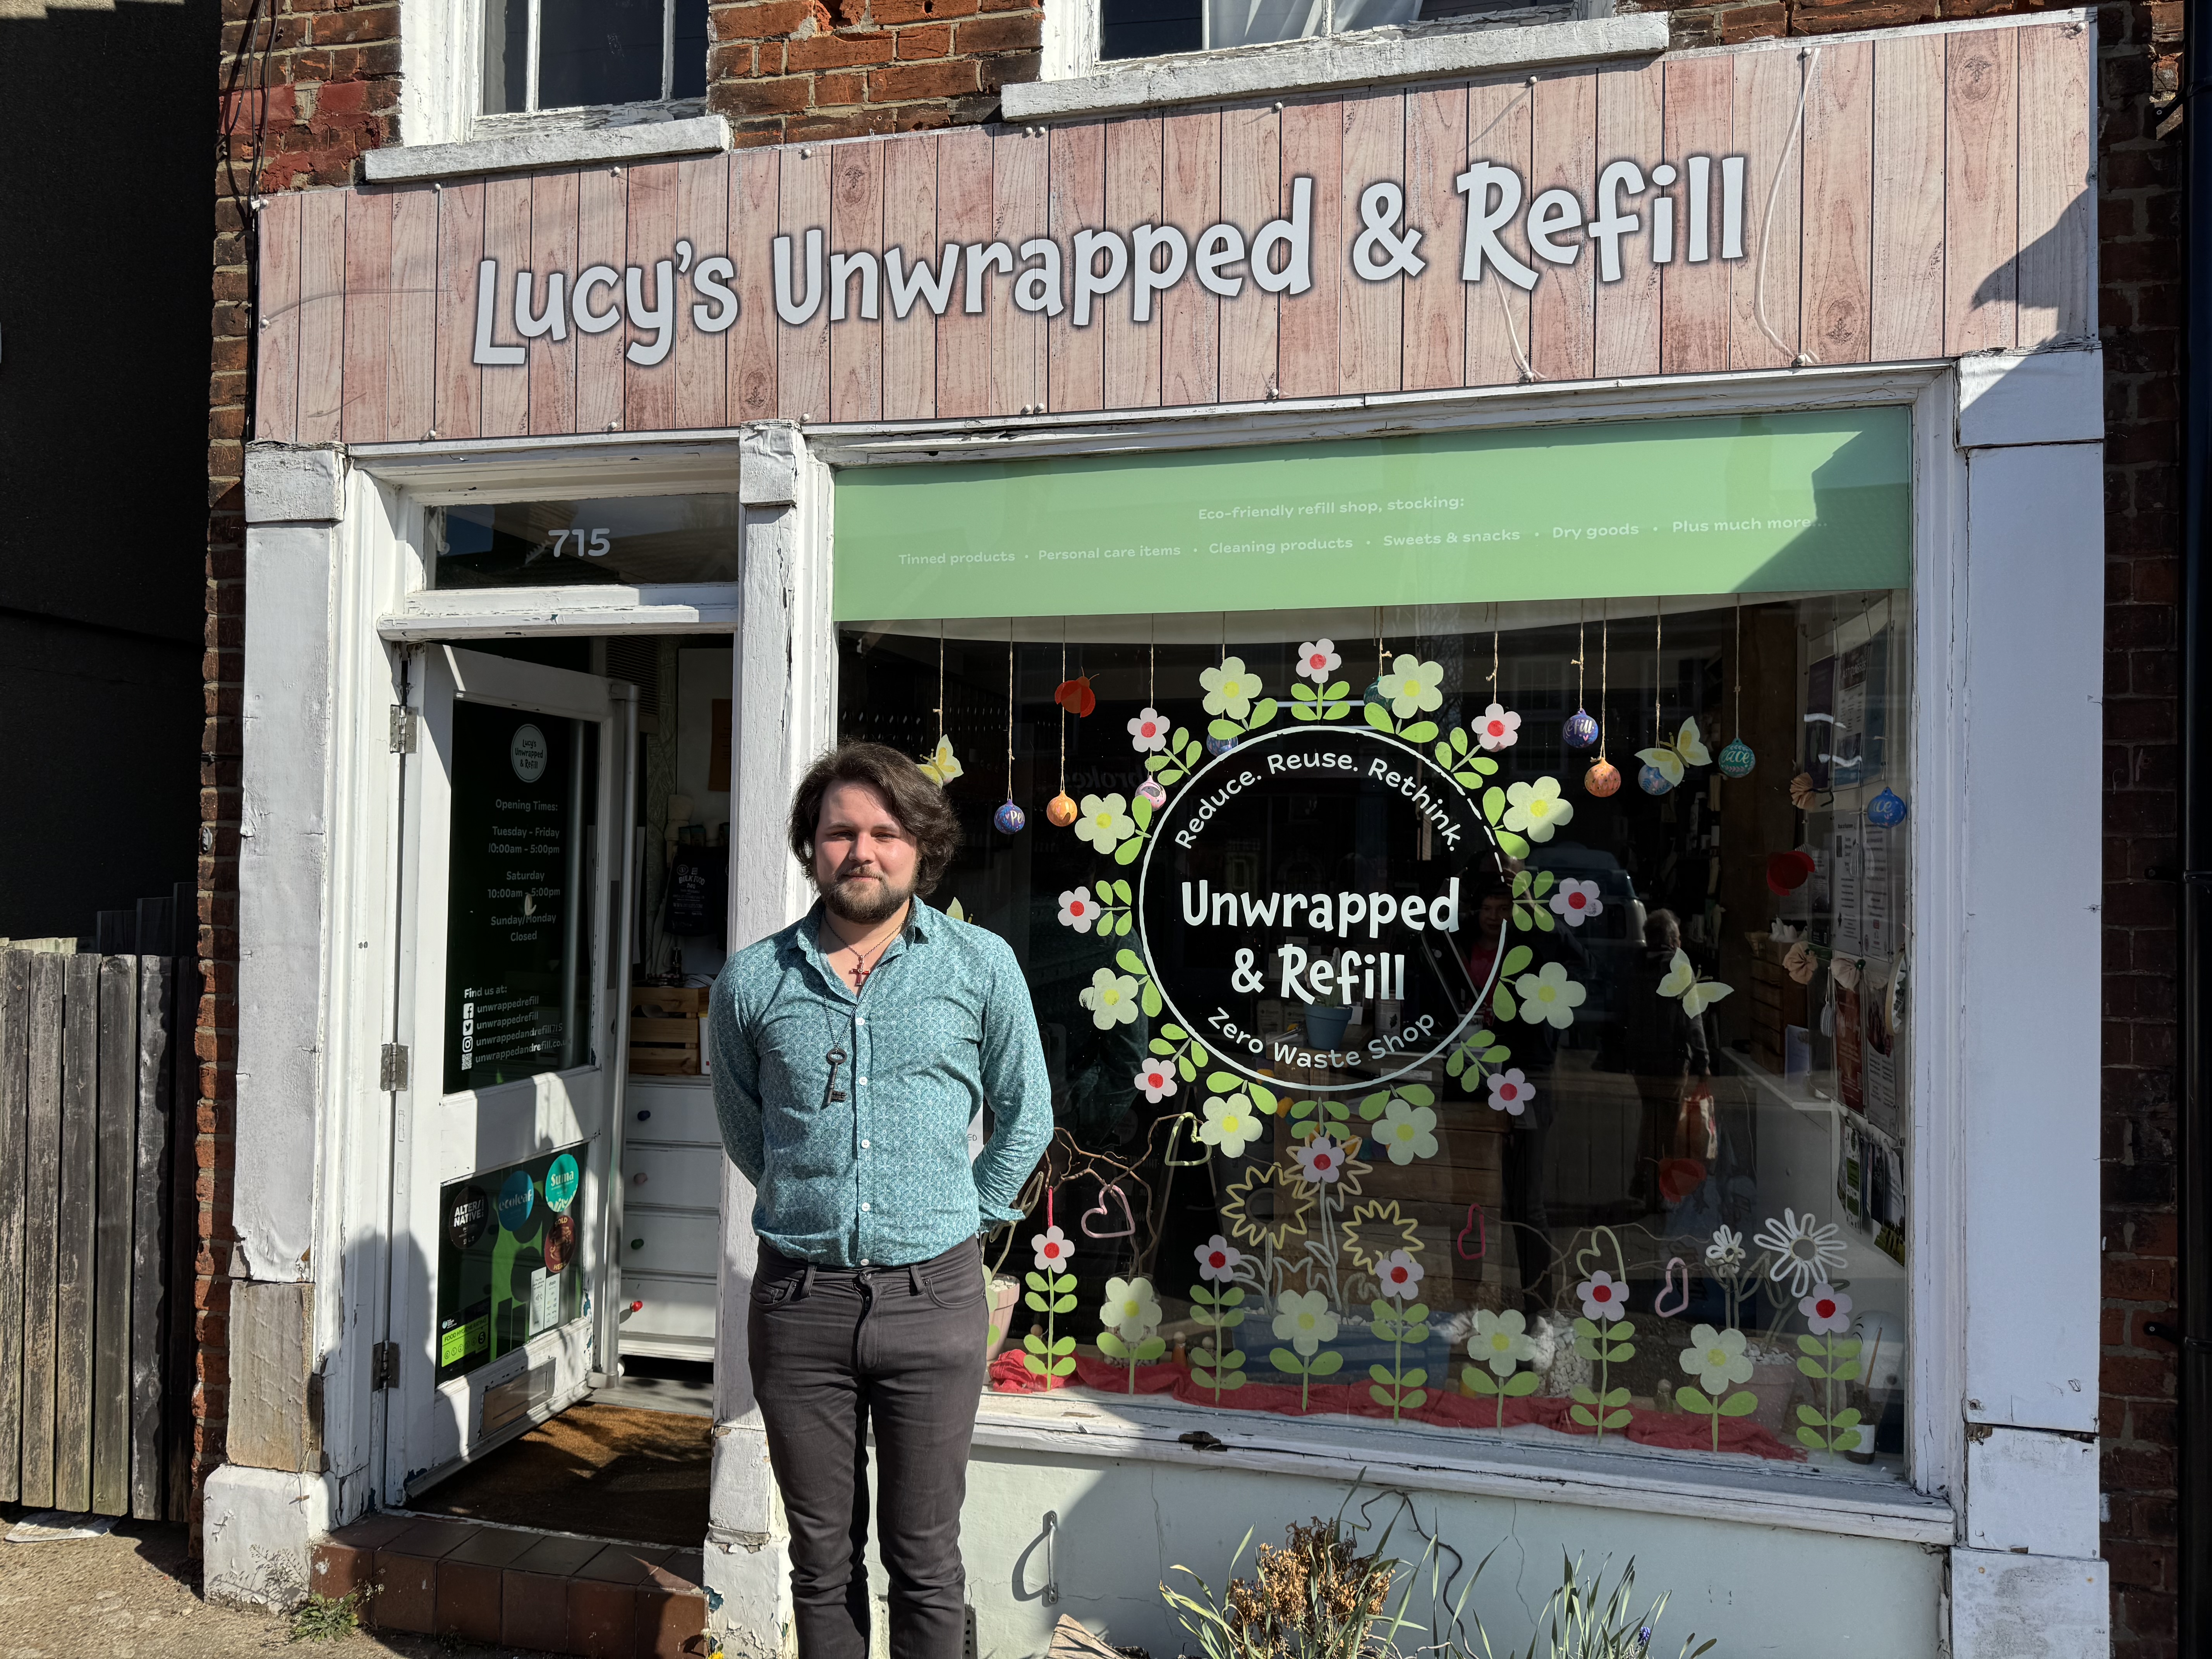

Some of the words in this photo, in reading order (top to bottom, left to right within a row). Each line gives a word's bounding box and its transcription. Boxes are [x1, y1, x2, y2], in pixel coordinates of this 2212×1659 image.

[472, 239, 737, 366] Lucy's
[772, 176, 1313, 327] Unwrapped
[1352, 182, 1422, 281] &
[1455, 155, 1746, 291] Refill
[1199, 504, 1294, 519] Eco-friendly
[1298, 502, 1334, 515] refill
[1340, 501, 1382, 514] shop,
[1387, 496, 1464, 510] stocking:
[548, 528, 610, 558] 715
[898, 553, 946, 565] Tinned
[950, 551, 1015, 566] products
[1039, 547, 1099, 560] Personal
[1104, 549, 1135, 558] care
[1140, 545, 1181, 556] items
[1209, 540, 1275, 554] Cleaning
[1281, 538, 1353, 554] products
[1383, 533, 1441, 546] Sweets
[1446, 532, 1458, 543] &
[1463, 529, 1520, 543] snacks
[1553, 527, 1582, 540] Dry
[1586, 523, 1639, 539] goods
[1673, 520, 1709, 532] Plus
[1714, 517, 1761, 531] much
[523, 739, 537, 749] Lucy's
[515, 748, 543, 758] Unwrapped
[525, 759, 538, 769] Refill
[495, 799, 531, 812] Opening
[532, 800, 558, 811] Times:
[1175, 770, 1262, 848] Reduce.
[1267, 752, 1358, 775] Reuse.
[1368, 757, 1462, 851] Rethink.
[492, 826, 527, 838] Tuesday
[535, 827, 560, 839] Friday
[488, 843, 522, 854] 10:00am
[530, 844, 560, 855] 5:00pm
[506, 870, 545, 882] Saturday
[488, 889, 523, 898] 10:00am
[531, 887, 560, 898] 5:00pm
[1182, 877, 1459, 938] Unwrapped
[491, 913, 556, 926] Sunday/Monday
[511, 931, 537, 942] Closed
[1231, 948, 1264, 993] &
[1278, 943, 1405, 1005] Refill
[464, 988, 482, 999] Find
[496, 985, 507, 994] at:
[477, 996, 539, 1013] unwrappedrefill
[476, 1011, 539, 1030] unwrappedrefill
[476, 1023, 563, 1047] unwrappedandrefill715
[1208, 1007, 1263, 1054] Zero
[1274, 1042, 1361, 1068] Waste
[1368, 1014, 1434, 1060] Shop
[551, 1171, 574, 1187] Suma
[454, 1209, 481, 1227] NATIVE
[554, 1217, 568, 1227] SOLD
[445, 1333, 457, 1342] FOOD
[480, 1333, 484, 1343] 5
